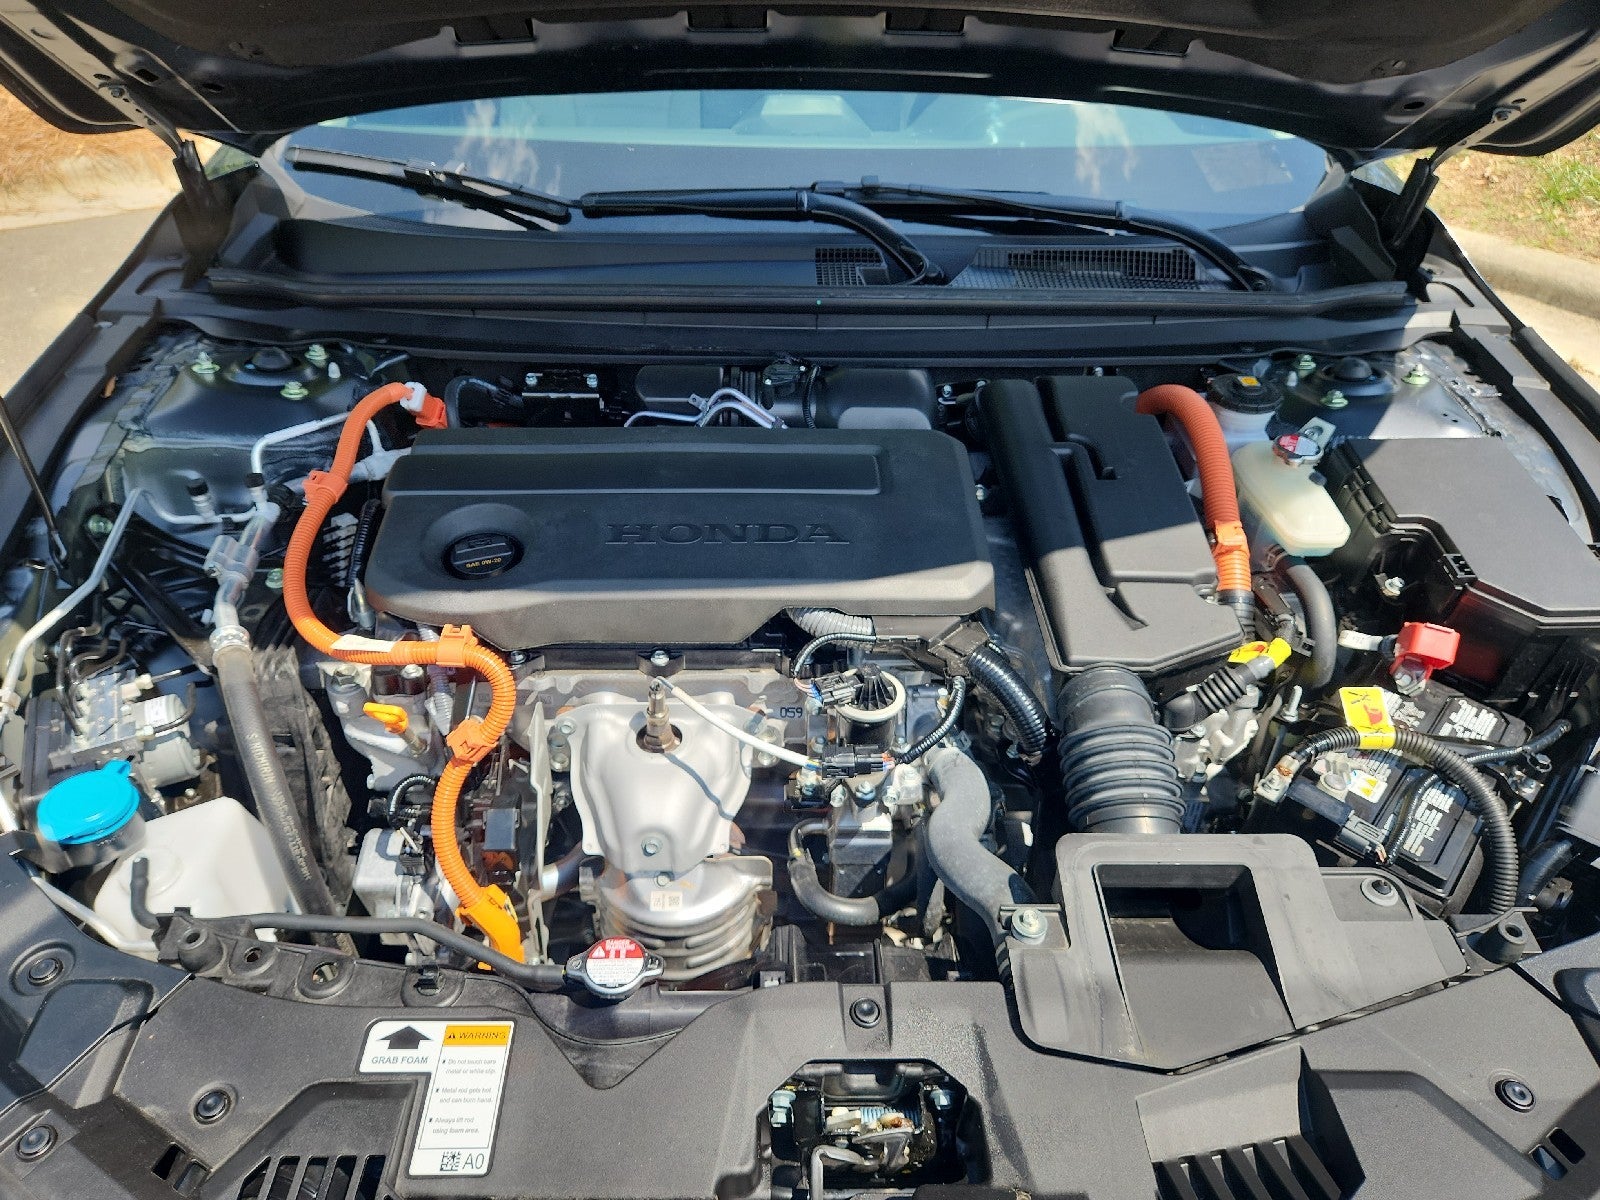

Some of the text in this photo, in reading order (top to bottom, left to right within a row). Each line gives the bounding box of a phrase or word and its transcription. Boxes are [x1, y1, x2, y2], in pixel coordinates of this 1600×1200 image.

[604, 523, 850, 545] HONDA
[459, 1031, 507, 1040] WARNING
[371, 1056, 428, 1064] GRAB FOAM
